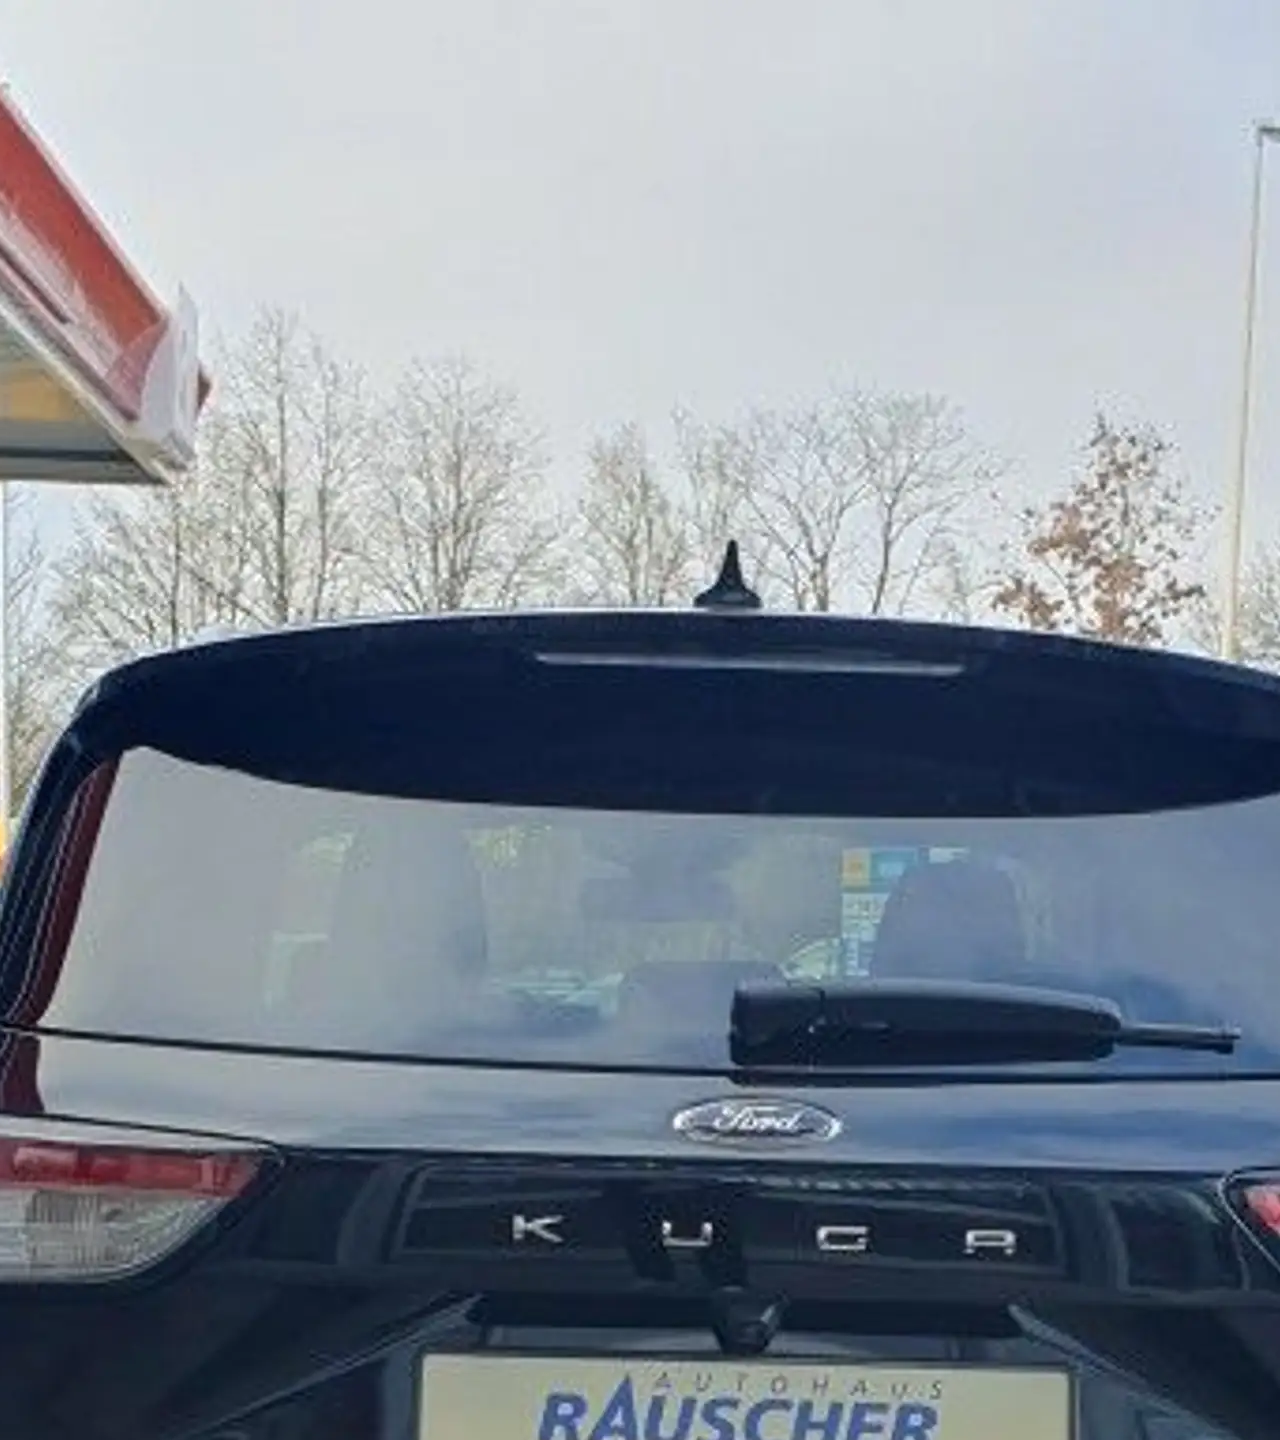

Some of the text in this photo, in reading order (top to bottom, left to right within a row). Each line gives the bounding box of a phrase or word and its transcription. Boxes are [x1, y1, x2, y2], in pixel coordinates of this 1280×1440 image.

[712, 1104, 807, 1134] Ford
[512, 1213, 1018, 1255] KUGA
[652, 1371, 945, 1401] AUTOHAUS
